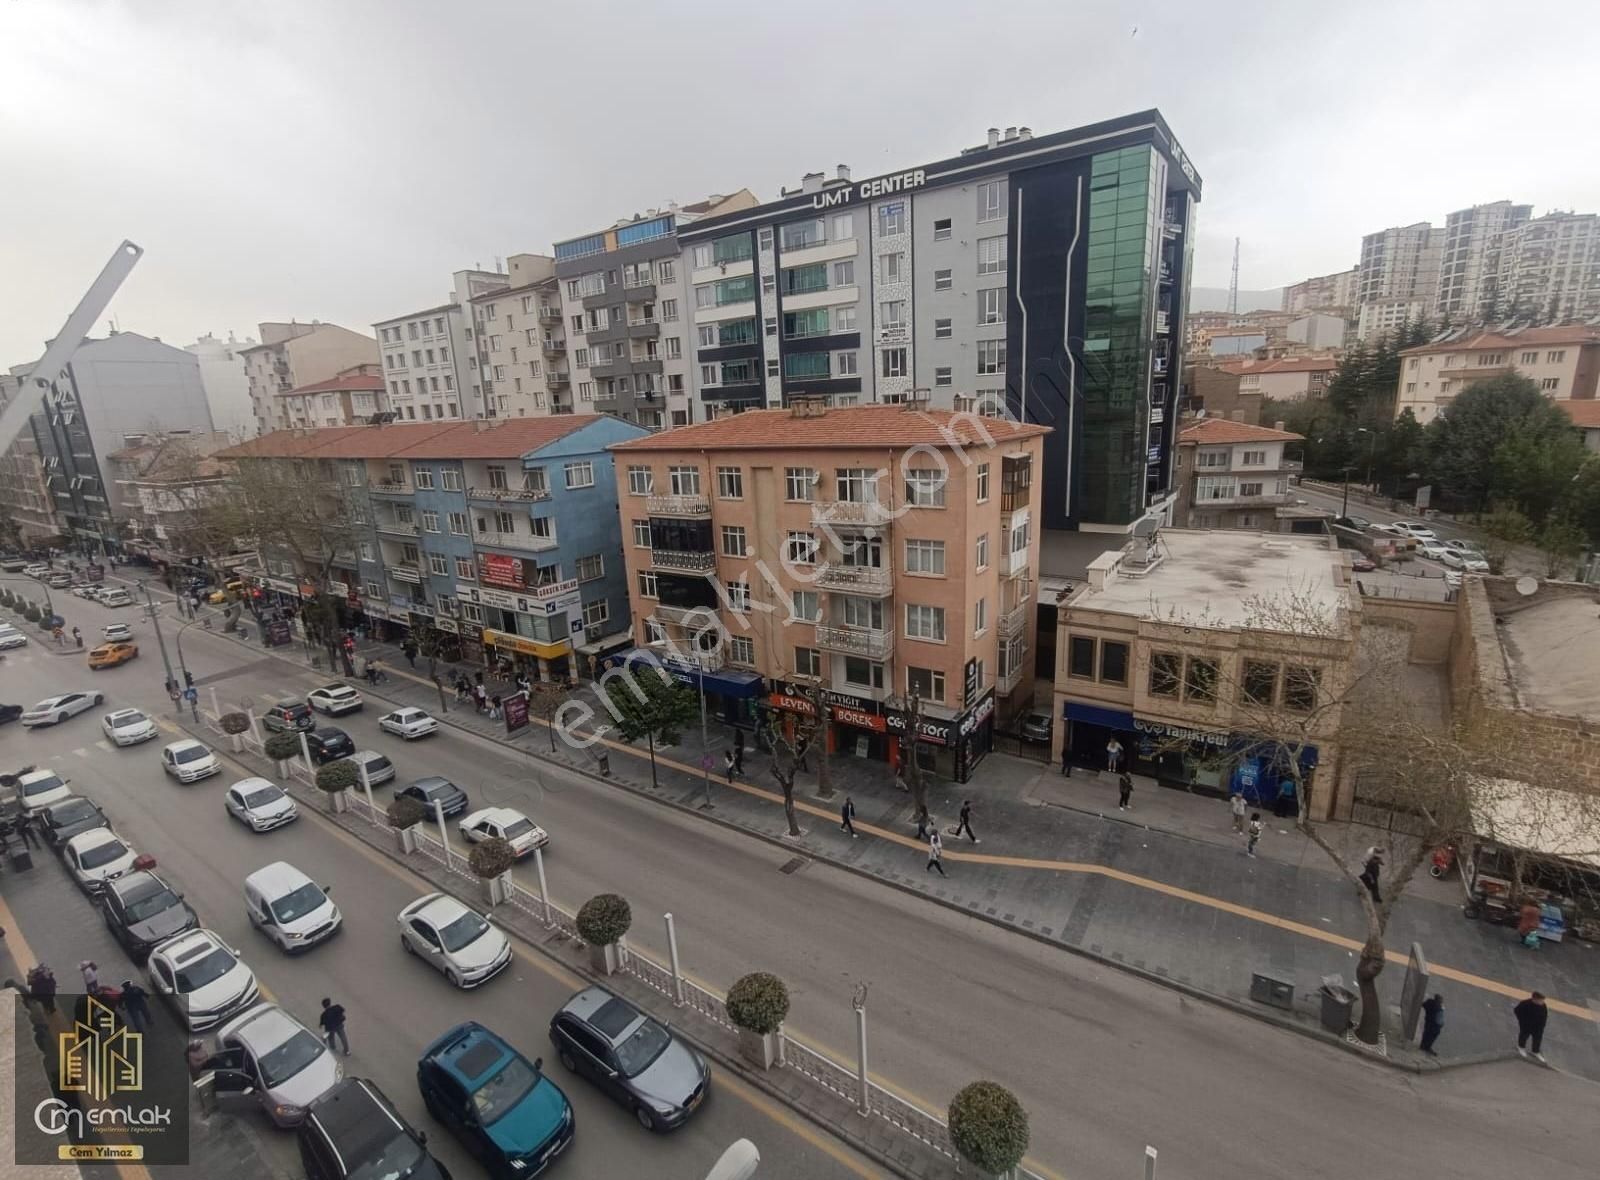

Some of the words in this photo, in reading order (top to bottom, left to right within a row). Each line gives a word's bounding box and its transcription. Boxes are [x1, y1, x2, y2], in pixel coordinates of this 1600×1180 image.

[812, 187, 853, 209] UMT
[859, 169, 926, 199] CENTER
[838, 710, 873, 728] BÖREK
